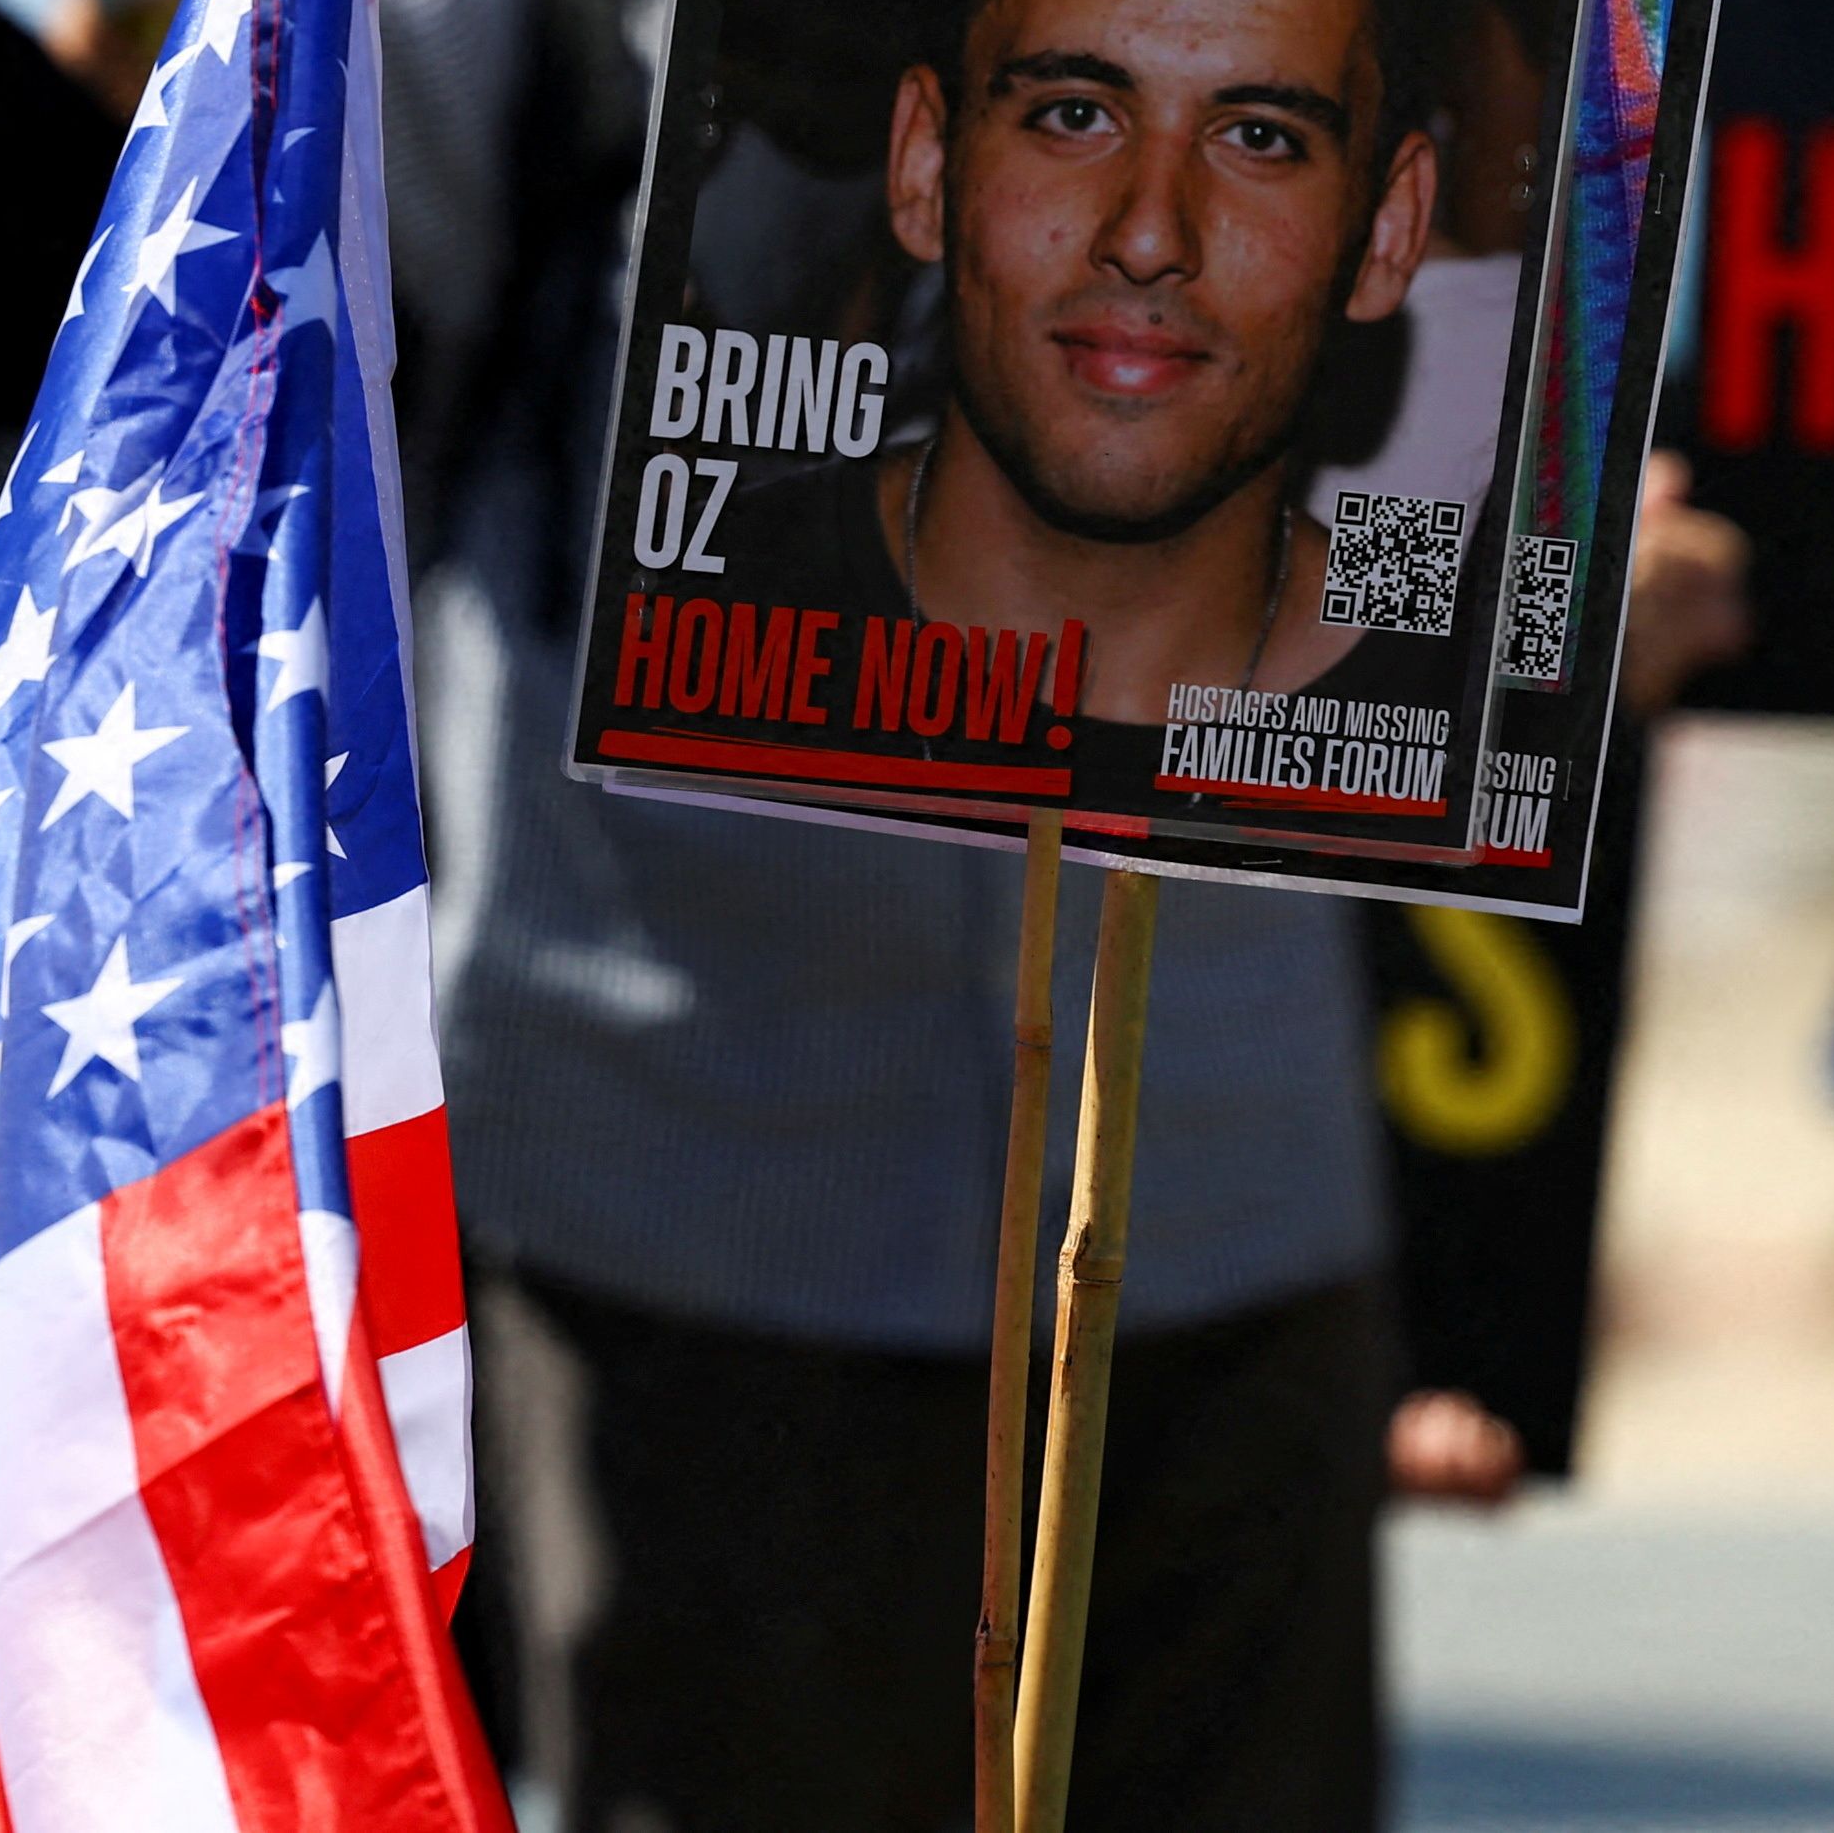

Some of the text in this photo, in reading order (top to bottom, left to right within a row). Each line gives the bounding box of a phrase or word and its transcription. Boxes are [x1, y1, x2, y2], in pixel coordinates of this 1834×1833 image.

[648, 322, 890, 459] BRING
[632, 452, 739, 574] OZ
[613, 592, 1086, 752] HOME NOW!
[1167, 682, 1451, 747] HOSTAGES AND MISSING
[1160, 723, 1447, 804] FAMILIES FORUM
